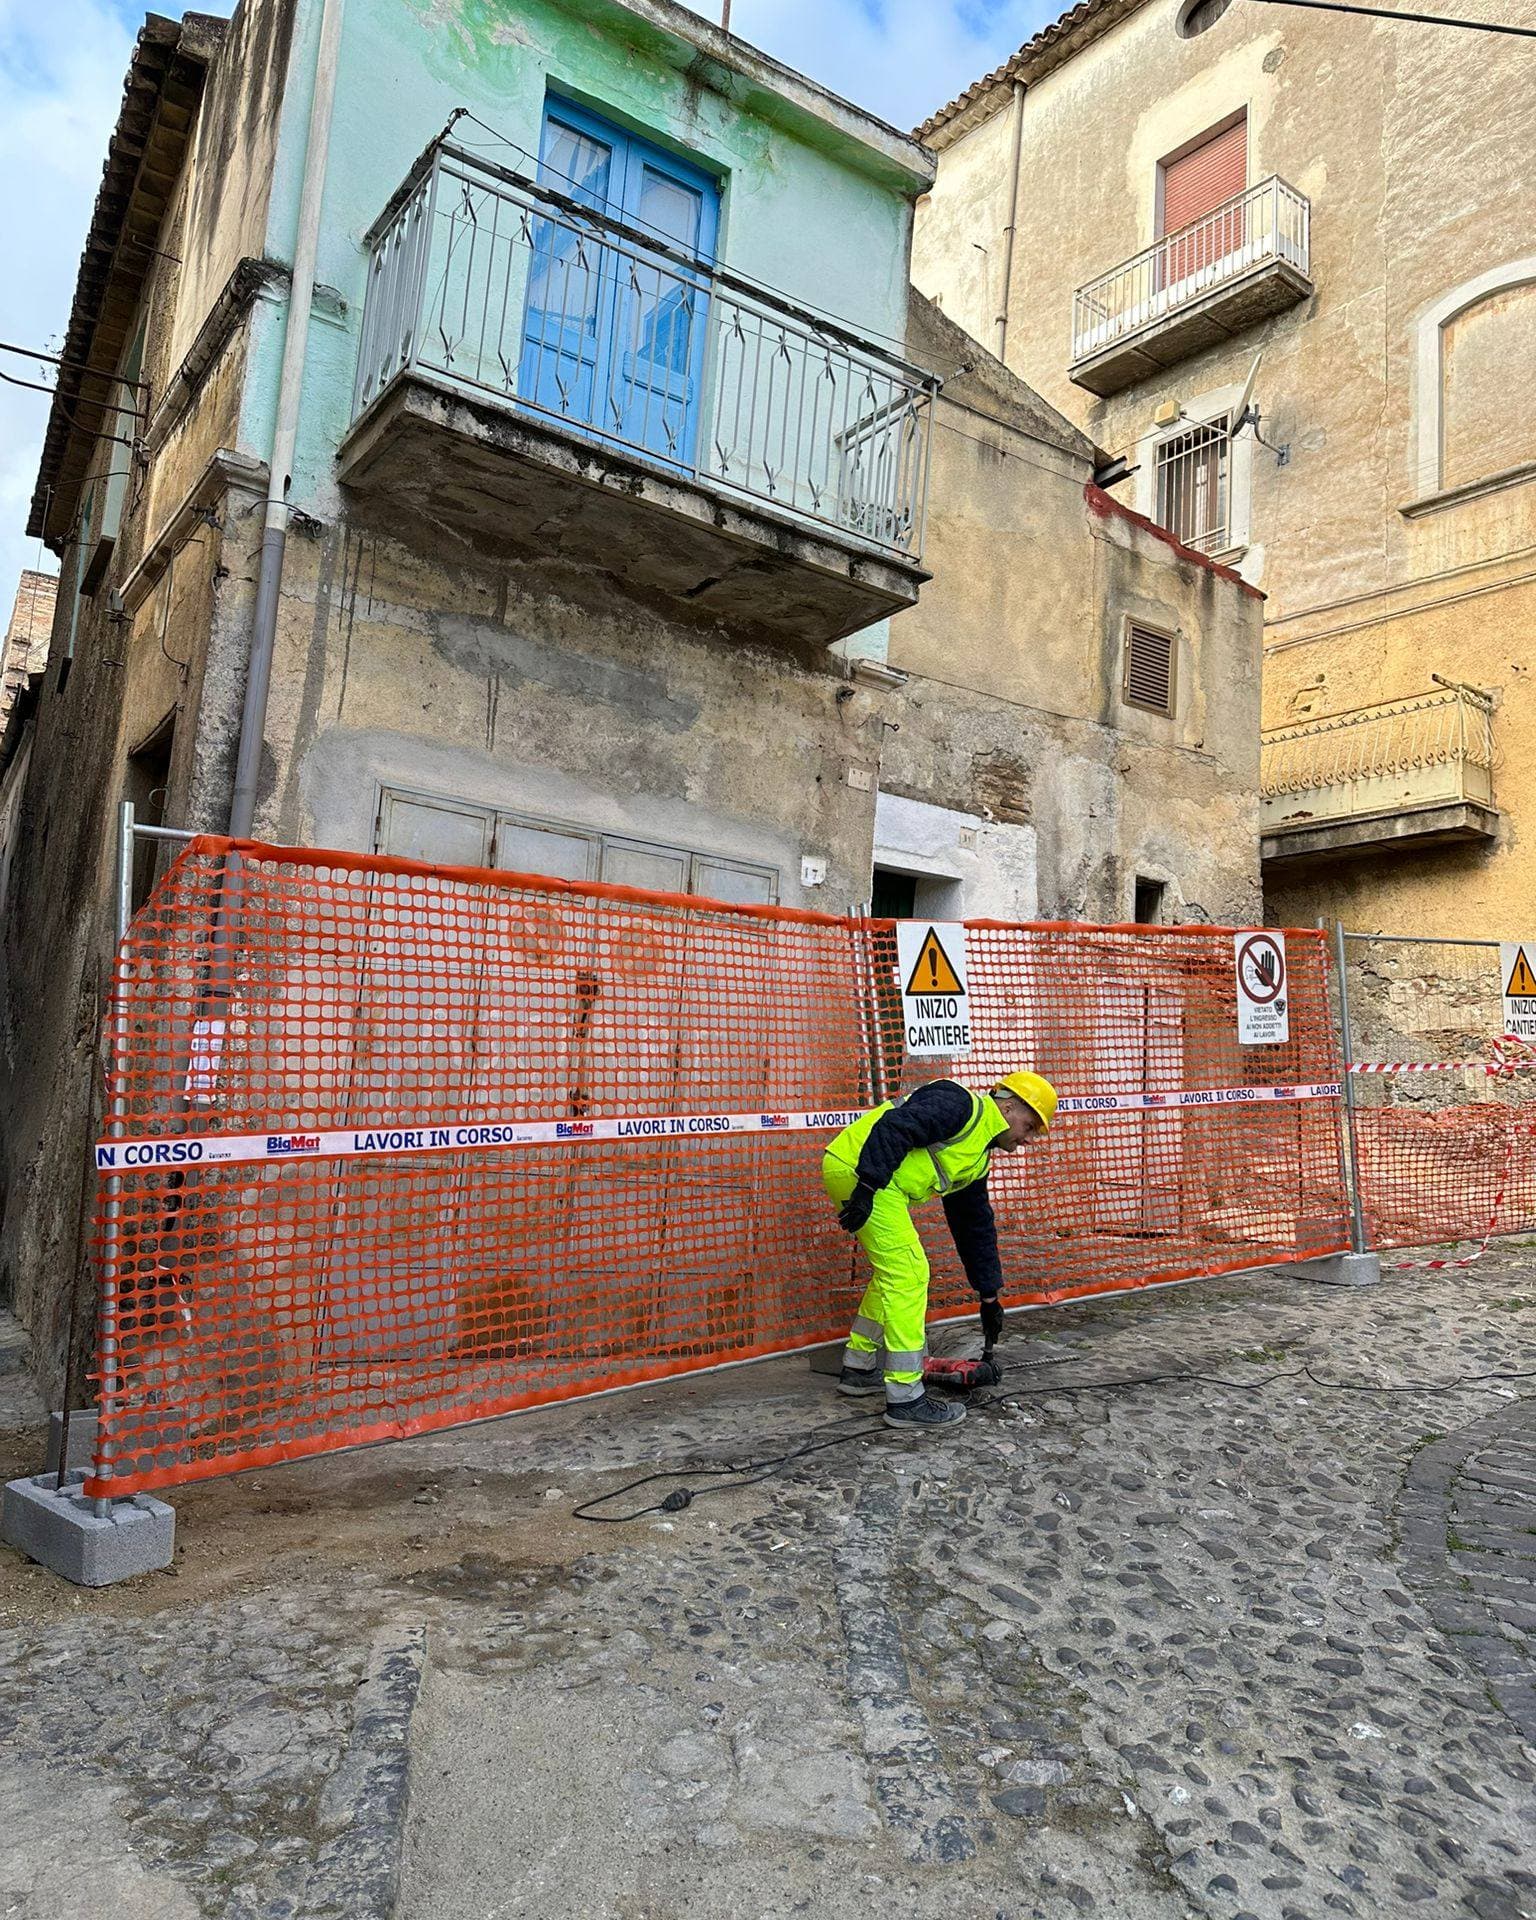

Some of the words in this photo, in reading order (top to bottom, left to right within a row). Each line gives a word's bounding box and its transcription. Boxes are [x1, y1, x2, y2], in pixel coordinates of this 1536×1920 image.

[915, 998, 958, 1019] INIZIO
[1505, 1019, 1536, 1035] CANTIE
[908, 1025, 970, 1047] CANTIERE
[1073, 1099, 1083, 1109] IN
[1085, 1097, 1118, 1109] CORSO
[1180, 1092, 1213, 1104] LAVORI
[1226, 1089, 1255, 1101] CORSO
[617, 1120, 666, 1136] LAVORI
[670, 1119, 685, 1133] IN
[689, 1117, 730, 1132] CORSO
[760, 1115, 790, 1125] BigMat
[805, 1113, 847, 1127] LAVORI
[848, 1112, 862, 1125] IN
[556, 1122, 594, 1135] BigMat
[266, 1135, 321, 1151] BigMat
[354, 1131, 423, 1151] LAVORI
[429, 1130, 450, 1147] IN
[456, 1126, 513, 1145] CORSO
[97, 1147, 116, 1167] N
[124, 1142, 203, 1165] CORSO
